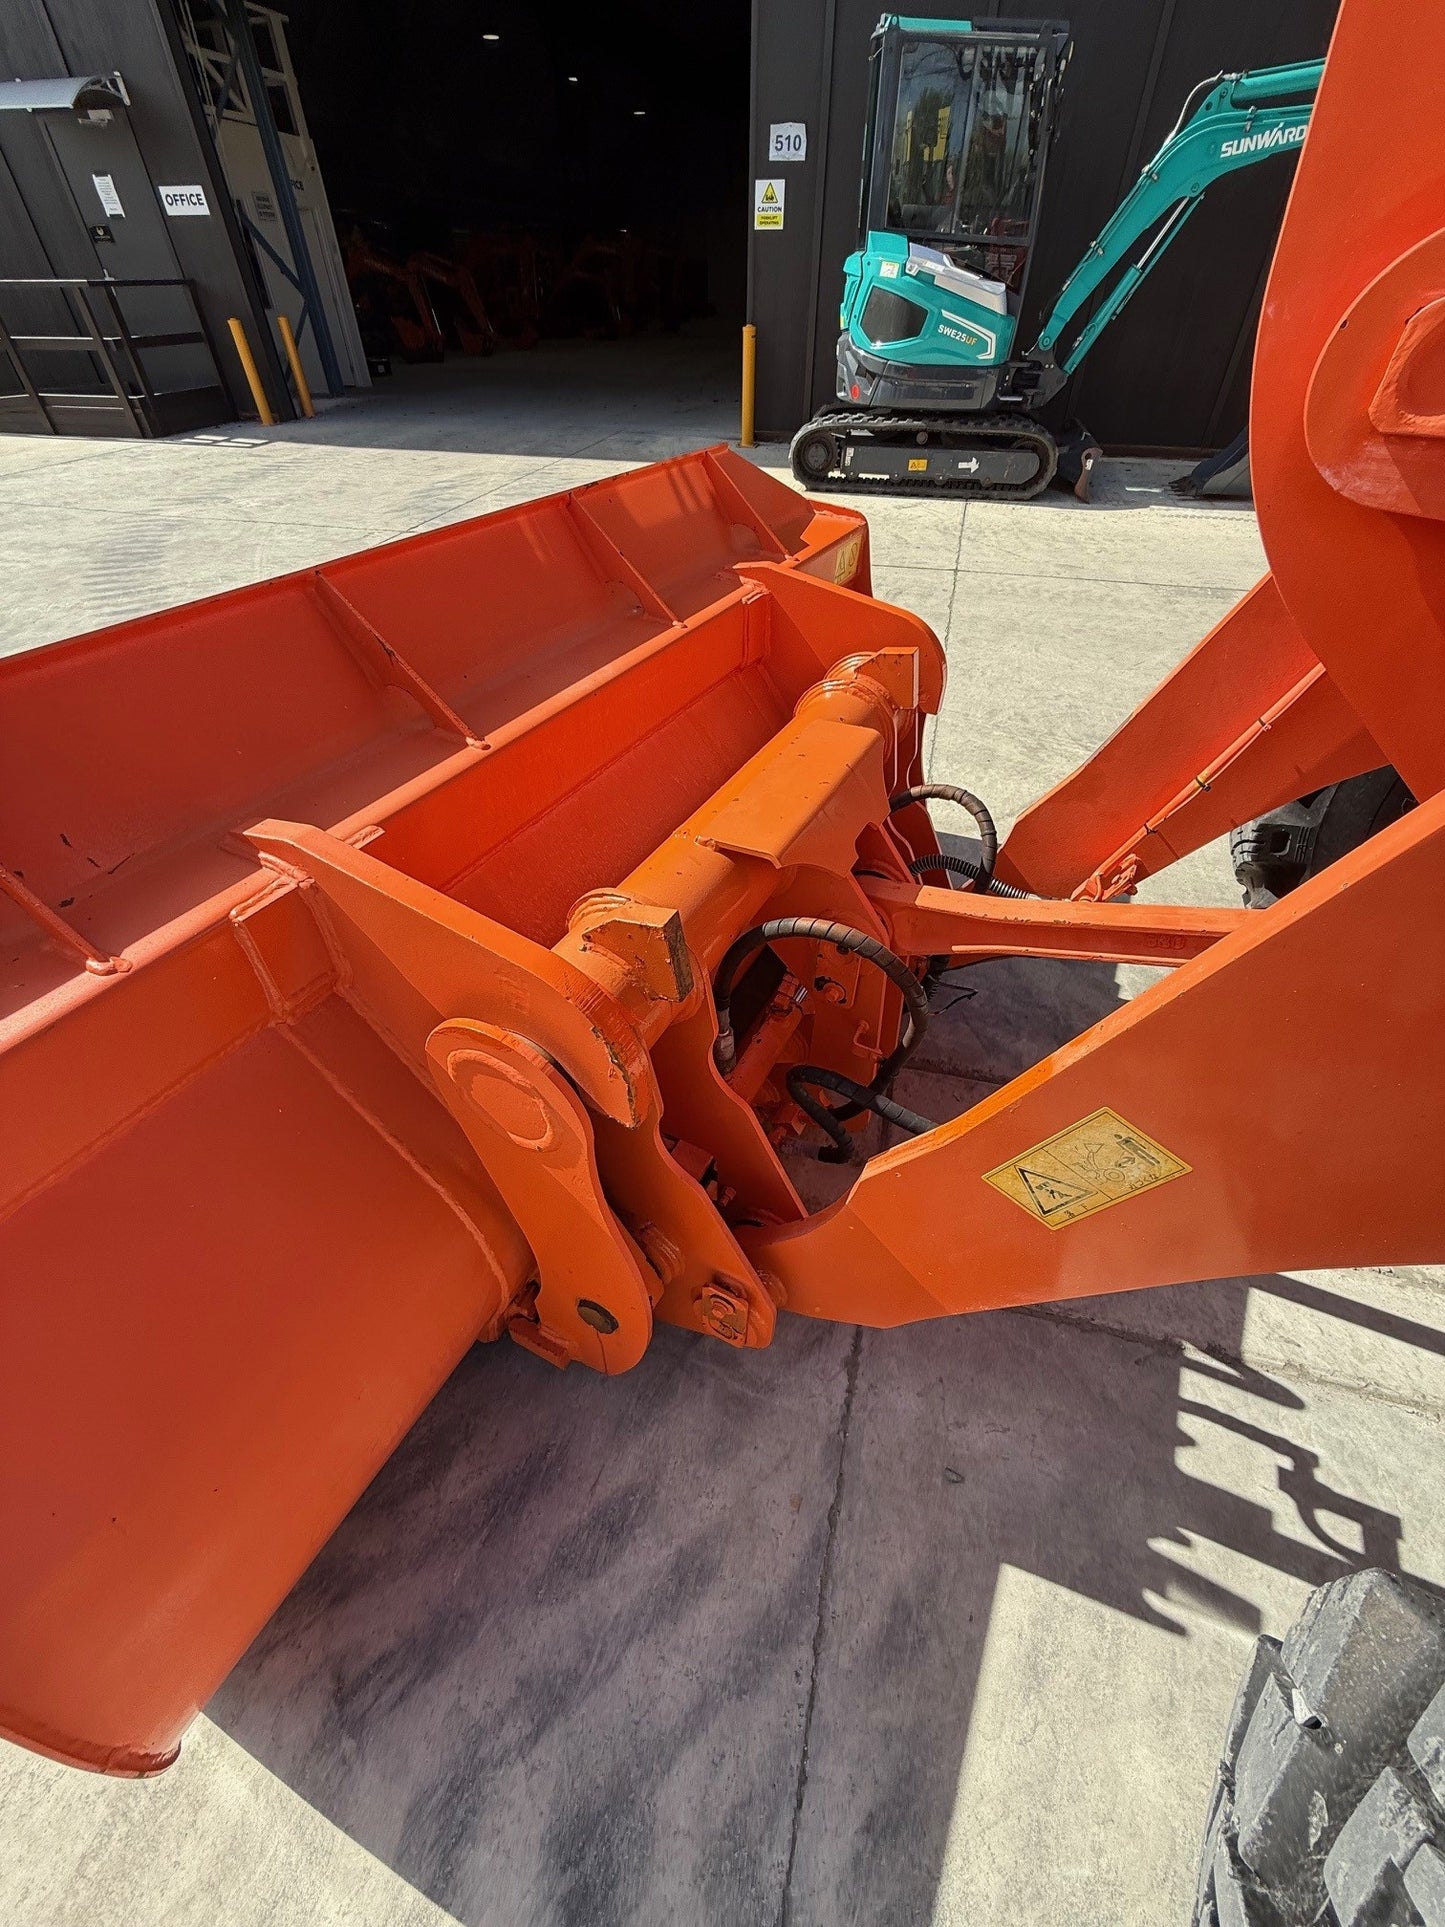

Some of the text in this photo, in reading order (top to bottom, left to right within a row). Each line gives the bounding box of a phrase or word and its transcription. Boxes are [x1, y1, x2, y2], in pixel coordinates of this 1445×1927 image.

[774, 134, 802, 151] 510
[1220, 122, 1309, 158] SUNWARD
[165, 193, 205, 206] OFFICE
[937, 324, 978, 346] SWE25UF
